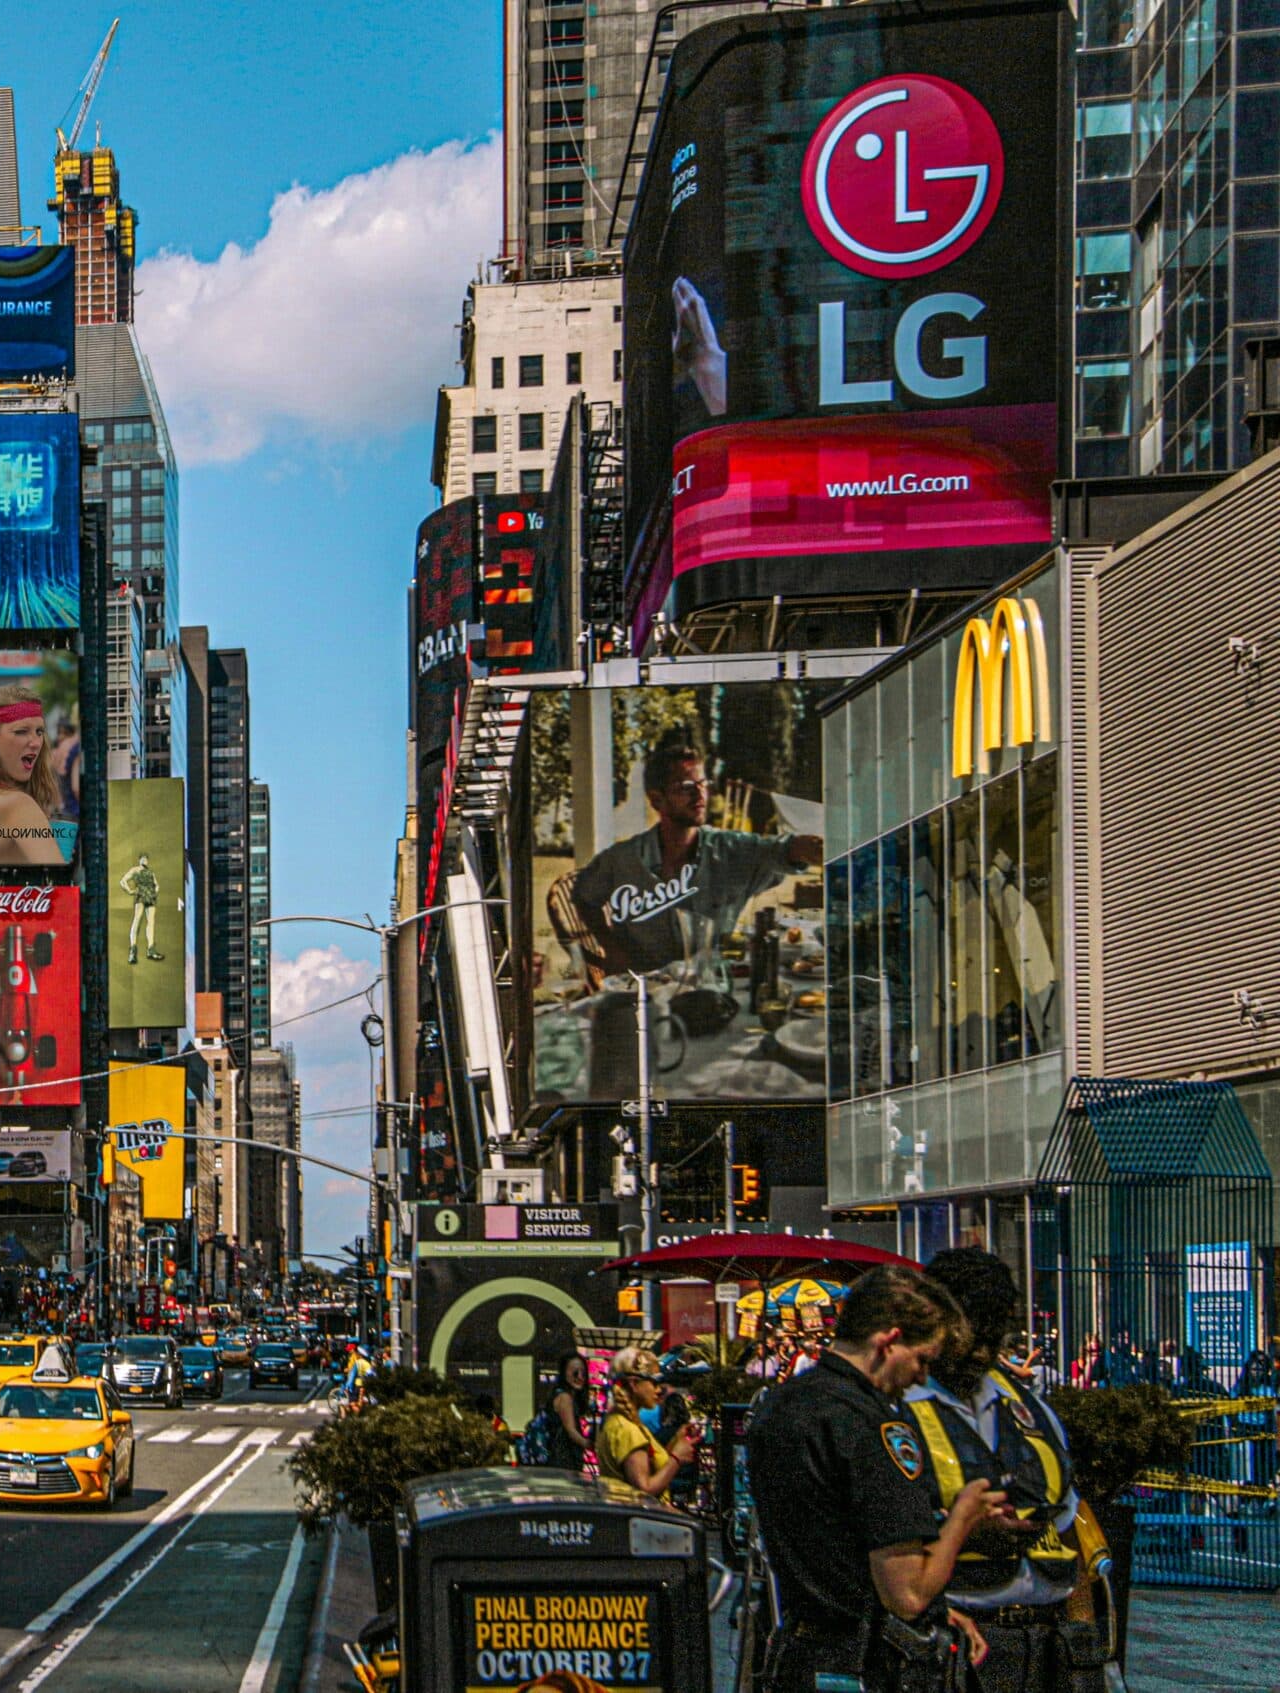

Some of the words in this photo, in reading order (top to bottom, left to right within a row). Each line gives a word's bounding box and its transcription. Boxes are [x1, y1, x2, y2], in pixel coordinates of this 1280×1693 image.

[818, 292, 988, 406] LG
[825, 472, 970, 498] www.LG.com
[610, 862, 698, 923] Persol
[524, 1208, 581, 1221] VISITOR
[524, 1224, 591, 1237] SERVICES
[519, 1520, 593, 1539] BigBelly
[474, 1595, 532, 1622] FINAL
[535, 1595, 649, 1622] BROADWAY
[475, 1621, 651, 1650] PERFORMANCE
[476, 1649, 615, 1681] OCTOBER
[619, 1650, 652, 1681] 27
